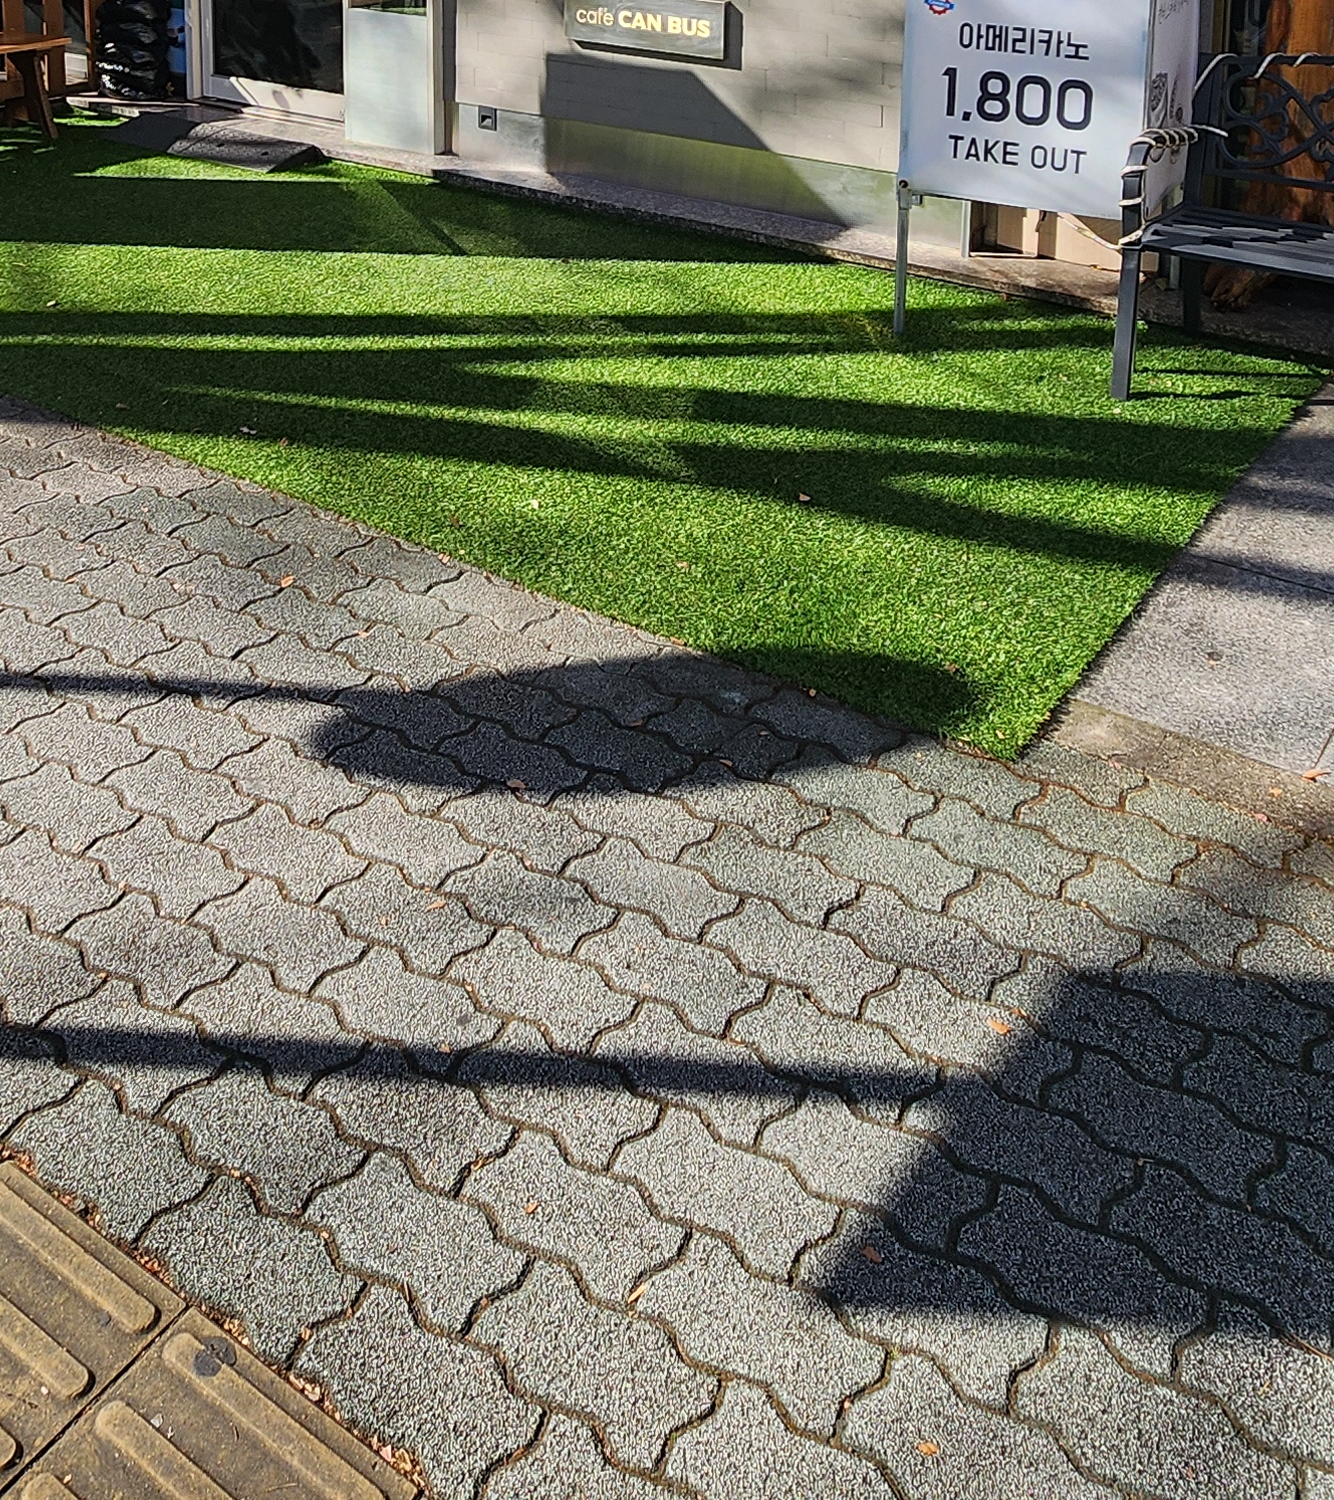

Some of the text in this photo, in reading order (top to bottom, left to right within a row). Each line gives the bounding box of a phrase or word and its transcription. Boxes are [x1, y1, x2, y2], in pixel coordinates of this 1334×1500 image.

[618, 9, 662, 33] CAN
[666, 14, 711, 39] BUS
[958, 22, 1090, 61] 아메리카노
[948, 135, 1087, 175] TAKE OUT
